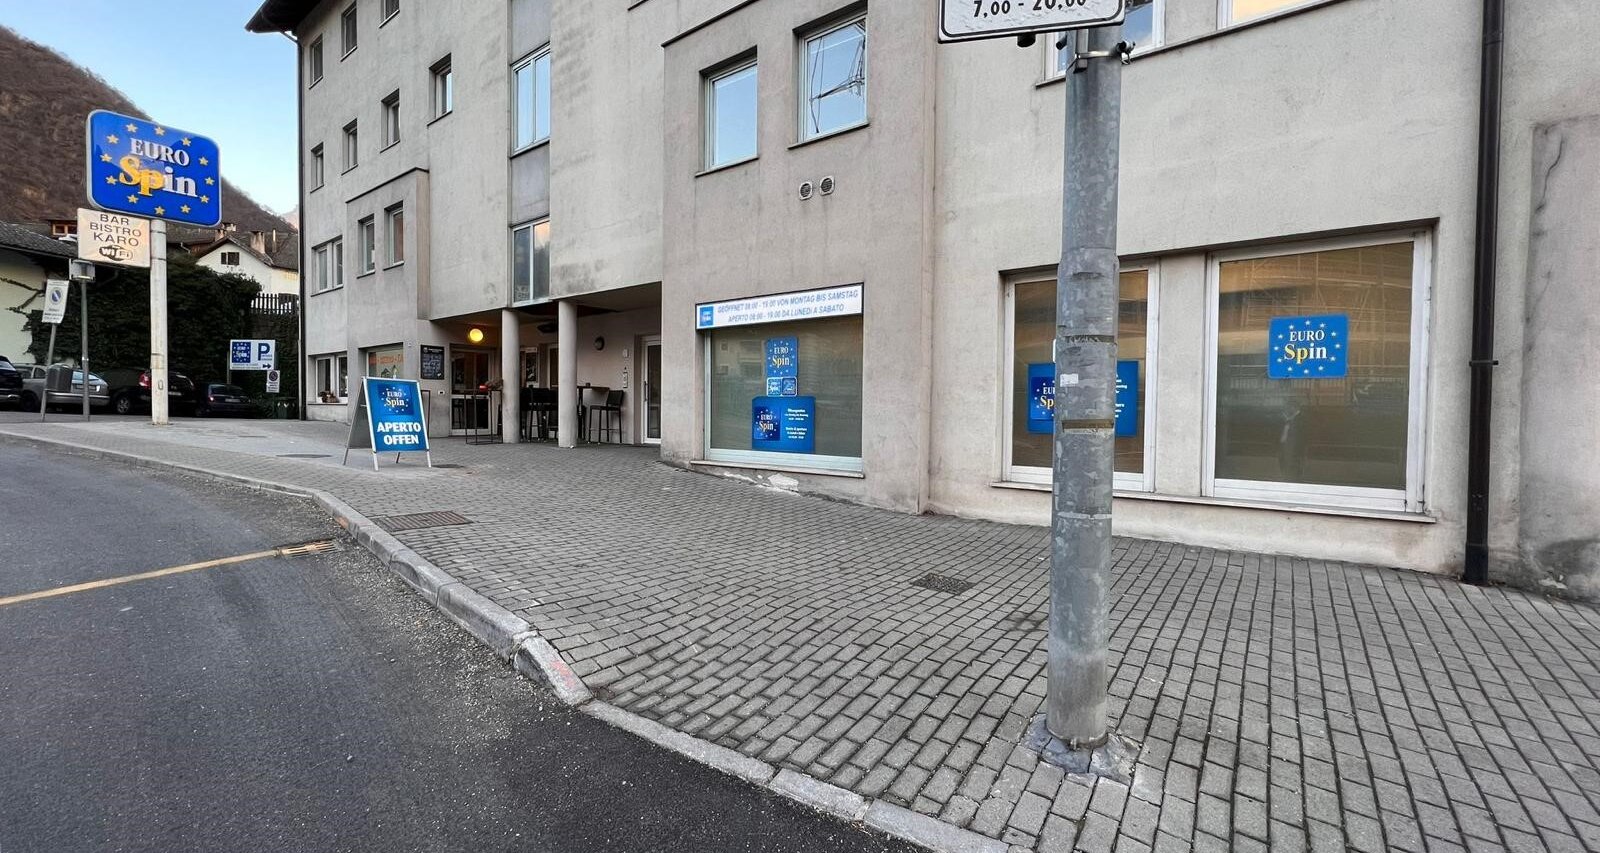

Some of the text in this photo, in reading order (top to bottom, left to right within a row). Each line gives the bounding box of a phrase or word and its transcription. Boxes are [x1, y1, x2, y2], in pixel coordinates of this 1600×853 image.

[974, 1, 1010, 18] 7,00
[130, 138, 190, 166] EURO
[119, 155, 199, 197] Spin
[100, 213, 130, 226] BAR
[90, 221, 142, 237] BISTRO
[93, 232, 139, 247] KARO
[777, 298, 789, 306] VON
[790, 295, 815, 304] MONTAG
[816, 293, 827, 302] BIS
[828, 289, 859, 300] SAMSTAG
[728, 313, 749, 322] APERTO
[782, 309, 790, 317] DA
[813, 306, 818, 314] A
[819, 303, 845, 314] SABATO
[1290, 329, 1325, 342] EURO
[258, 343, 271, 361] P
[773, 346, 789, 355] EURO
[1284, 342, 1327, 364] Spin
[772, 355, 790, 368] Spin
[1043, 387, 1056, 395] EU
[385, 397, 405, 408] Spin
[1040, 395, 1055, 410] Sp
[760, 413, 773, 421] EURO
[377, 422, 421, 433] APERTO
[758, 420, 774, 432] Spin
[383, 434, 420, 445] OFFEN
